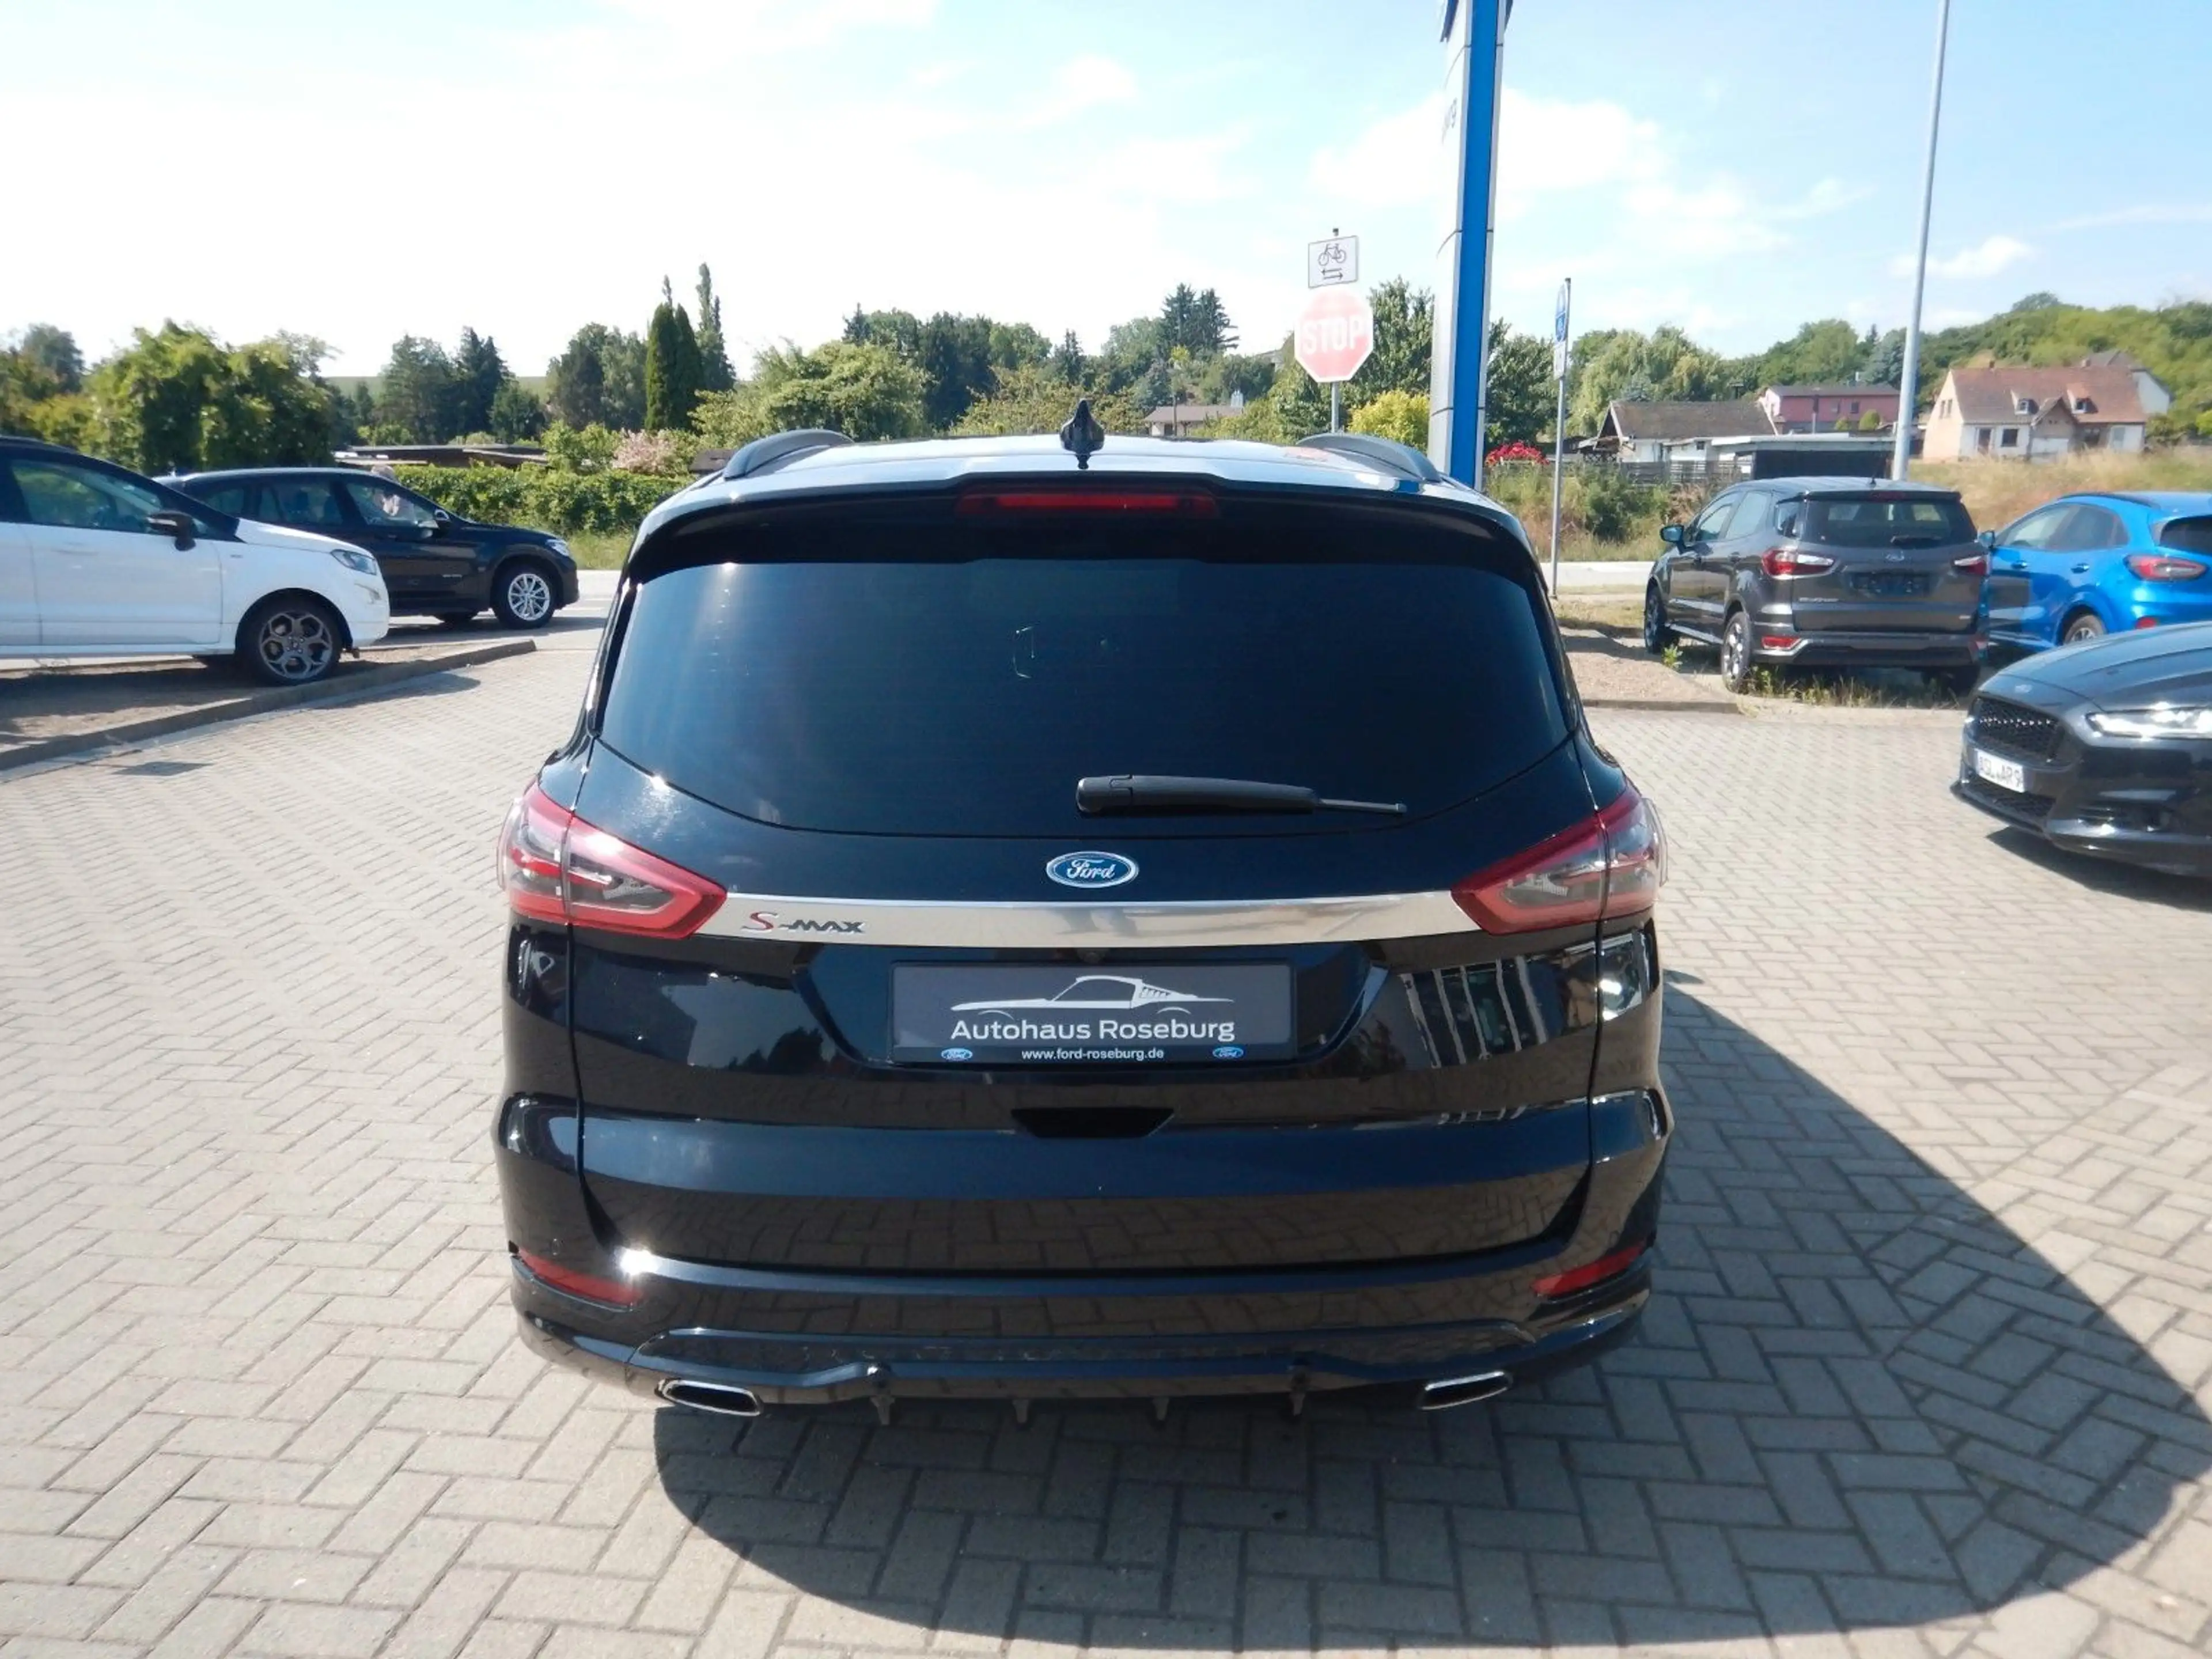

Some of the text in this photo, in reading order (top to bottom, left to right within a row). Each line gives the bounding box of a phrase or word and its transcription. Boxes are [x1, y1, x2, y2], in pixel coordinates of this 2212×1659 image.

[1303, 317, 1362, 355] STOP
[1066, 859, 1116, 879] Ford
[950, 1018, 1236, 1042] Autohaus Roseburg
[1021, 1047, 1164, 1060] www.ford-roseburg.de
